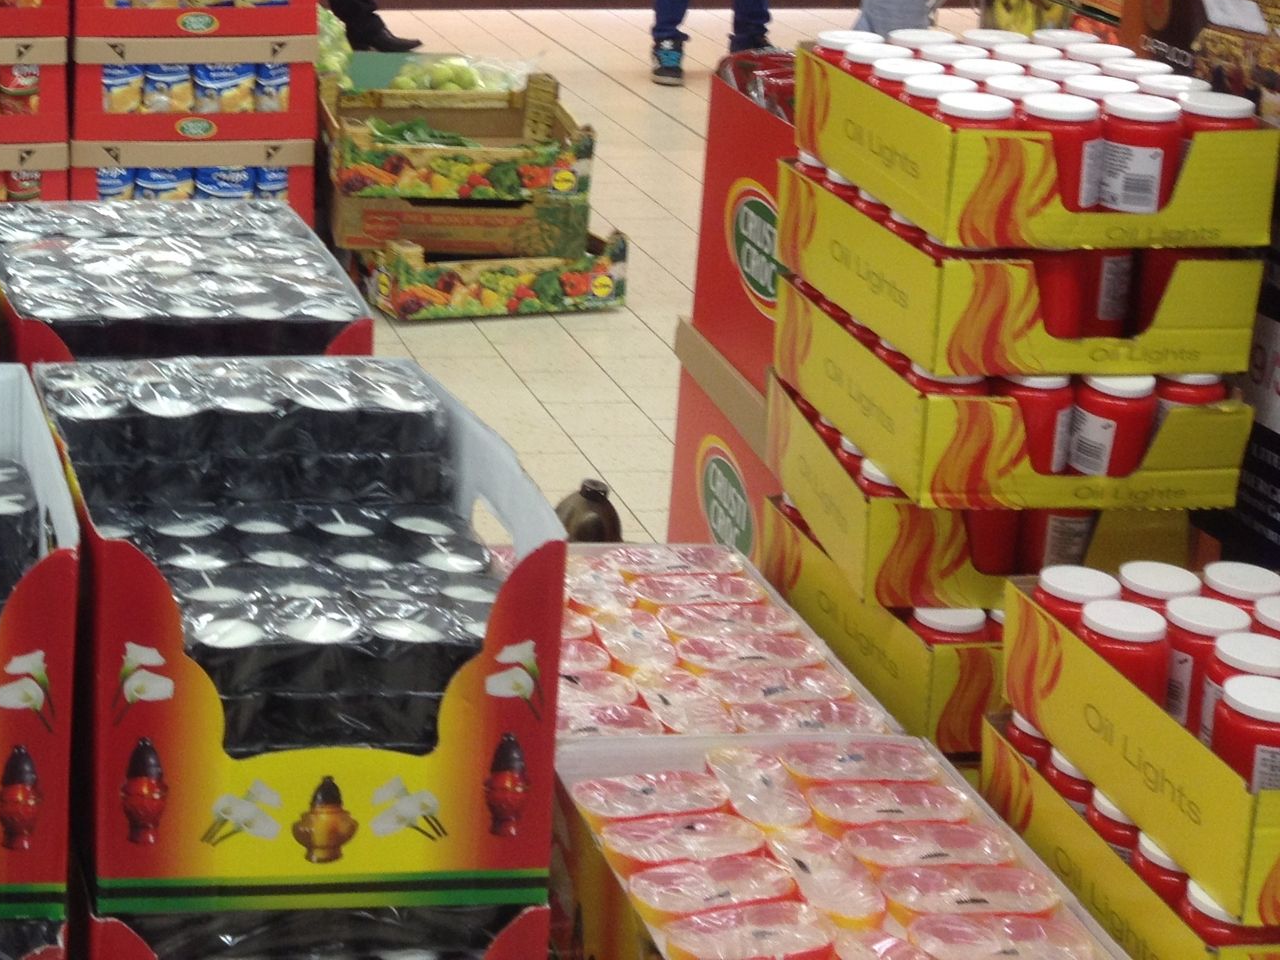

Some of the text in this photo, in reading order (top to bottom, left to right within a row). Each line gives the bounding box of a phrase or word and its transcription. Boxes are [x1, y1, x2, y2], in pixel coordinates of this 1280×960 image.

[843, 118, 920, 180] Oil Lights
[831, 239, 910, 310] Oil Lights
[824, 356, 897, 435] Oil Lights
[709, 462, 747, 531] CRUSTI
[1083, 702, 1202, 827] Oil Lights
[1055, 845, 1082, 891] Oil
